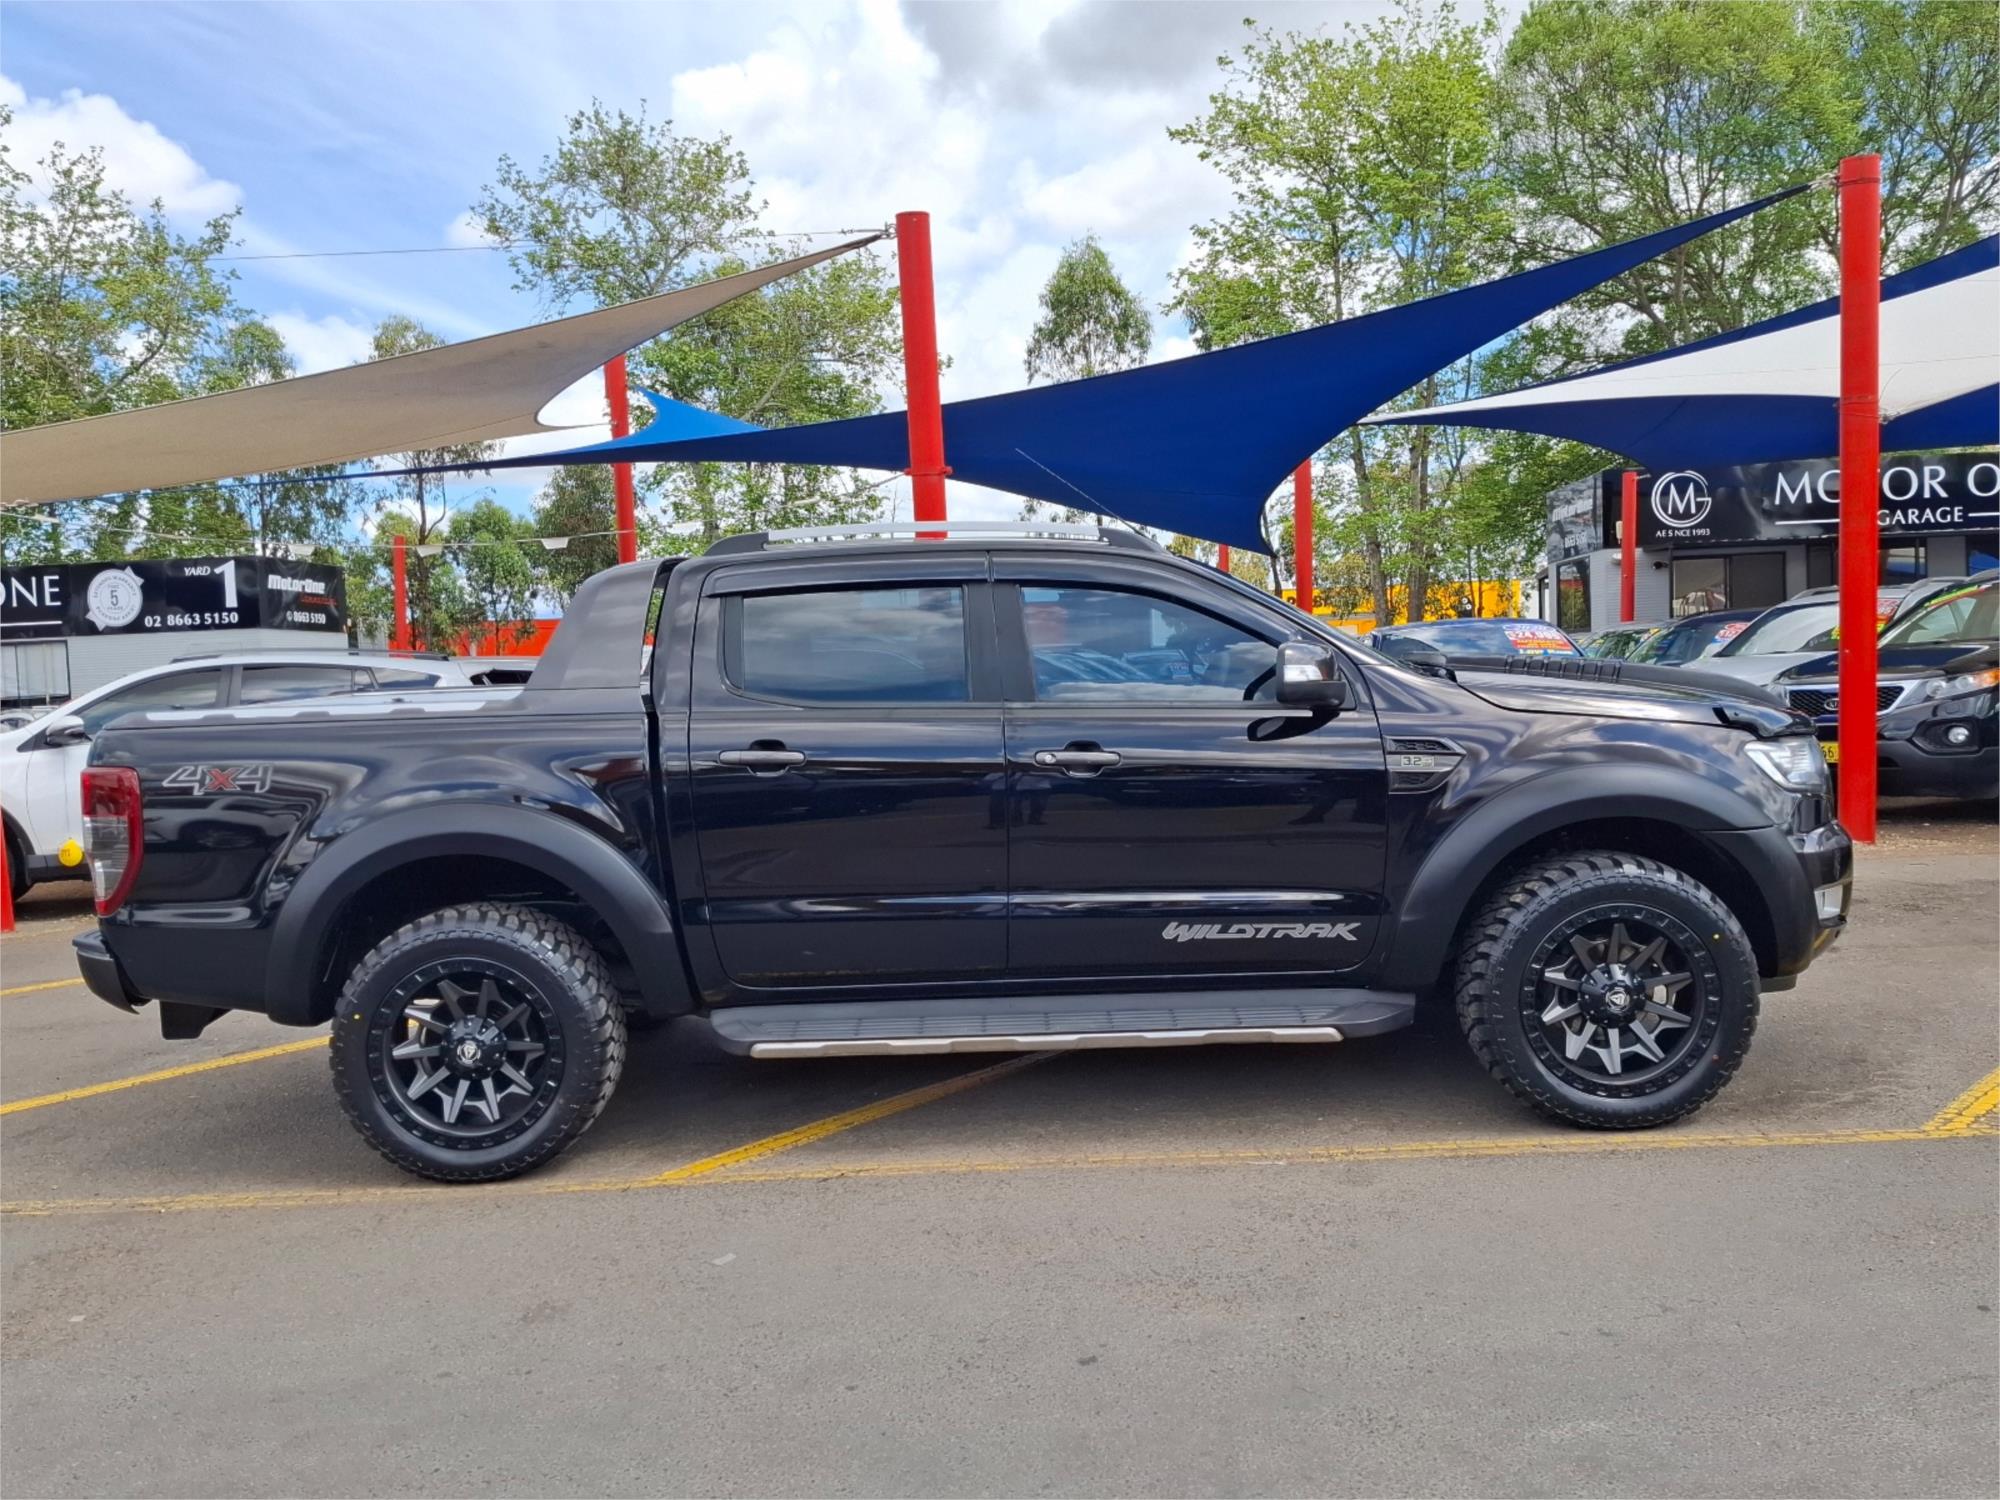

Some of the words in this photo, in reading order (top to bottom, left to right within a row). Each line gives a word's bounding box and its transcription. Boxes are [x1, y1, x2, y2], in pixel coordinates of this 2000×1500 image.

[1774, 465, 1949, 506] MOOR
[1875, 506, 1964, 526] GARAGE
[1668, 528, 1691, 537] SNCE
[0, 575, 62, 607] NE
[184, 566, 211, 576] YARD
[214, 560, 238, 608] 1
[144, 615, 162, 627] 02
[167, 613, 201, 626] 8663
[204, 612, 239, 624] 5150
[293, 611, 309, 623] 8663
[310, 612, 326, 625] 5150
[1162, 921, 1362, 943] WILDTRAK
